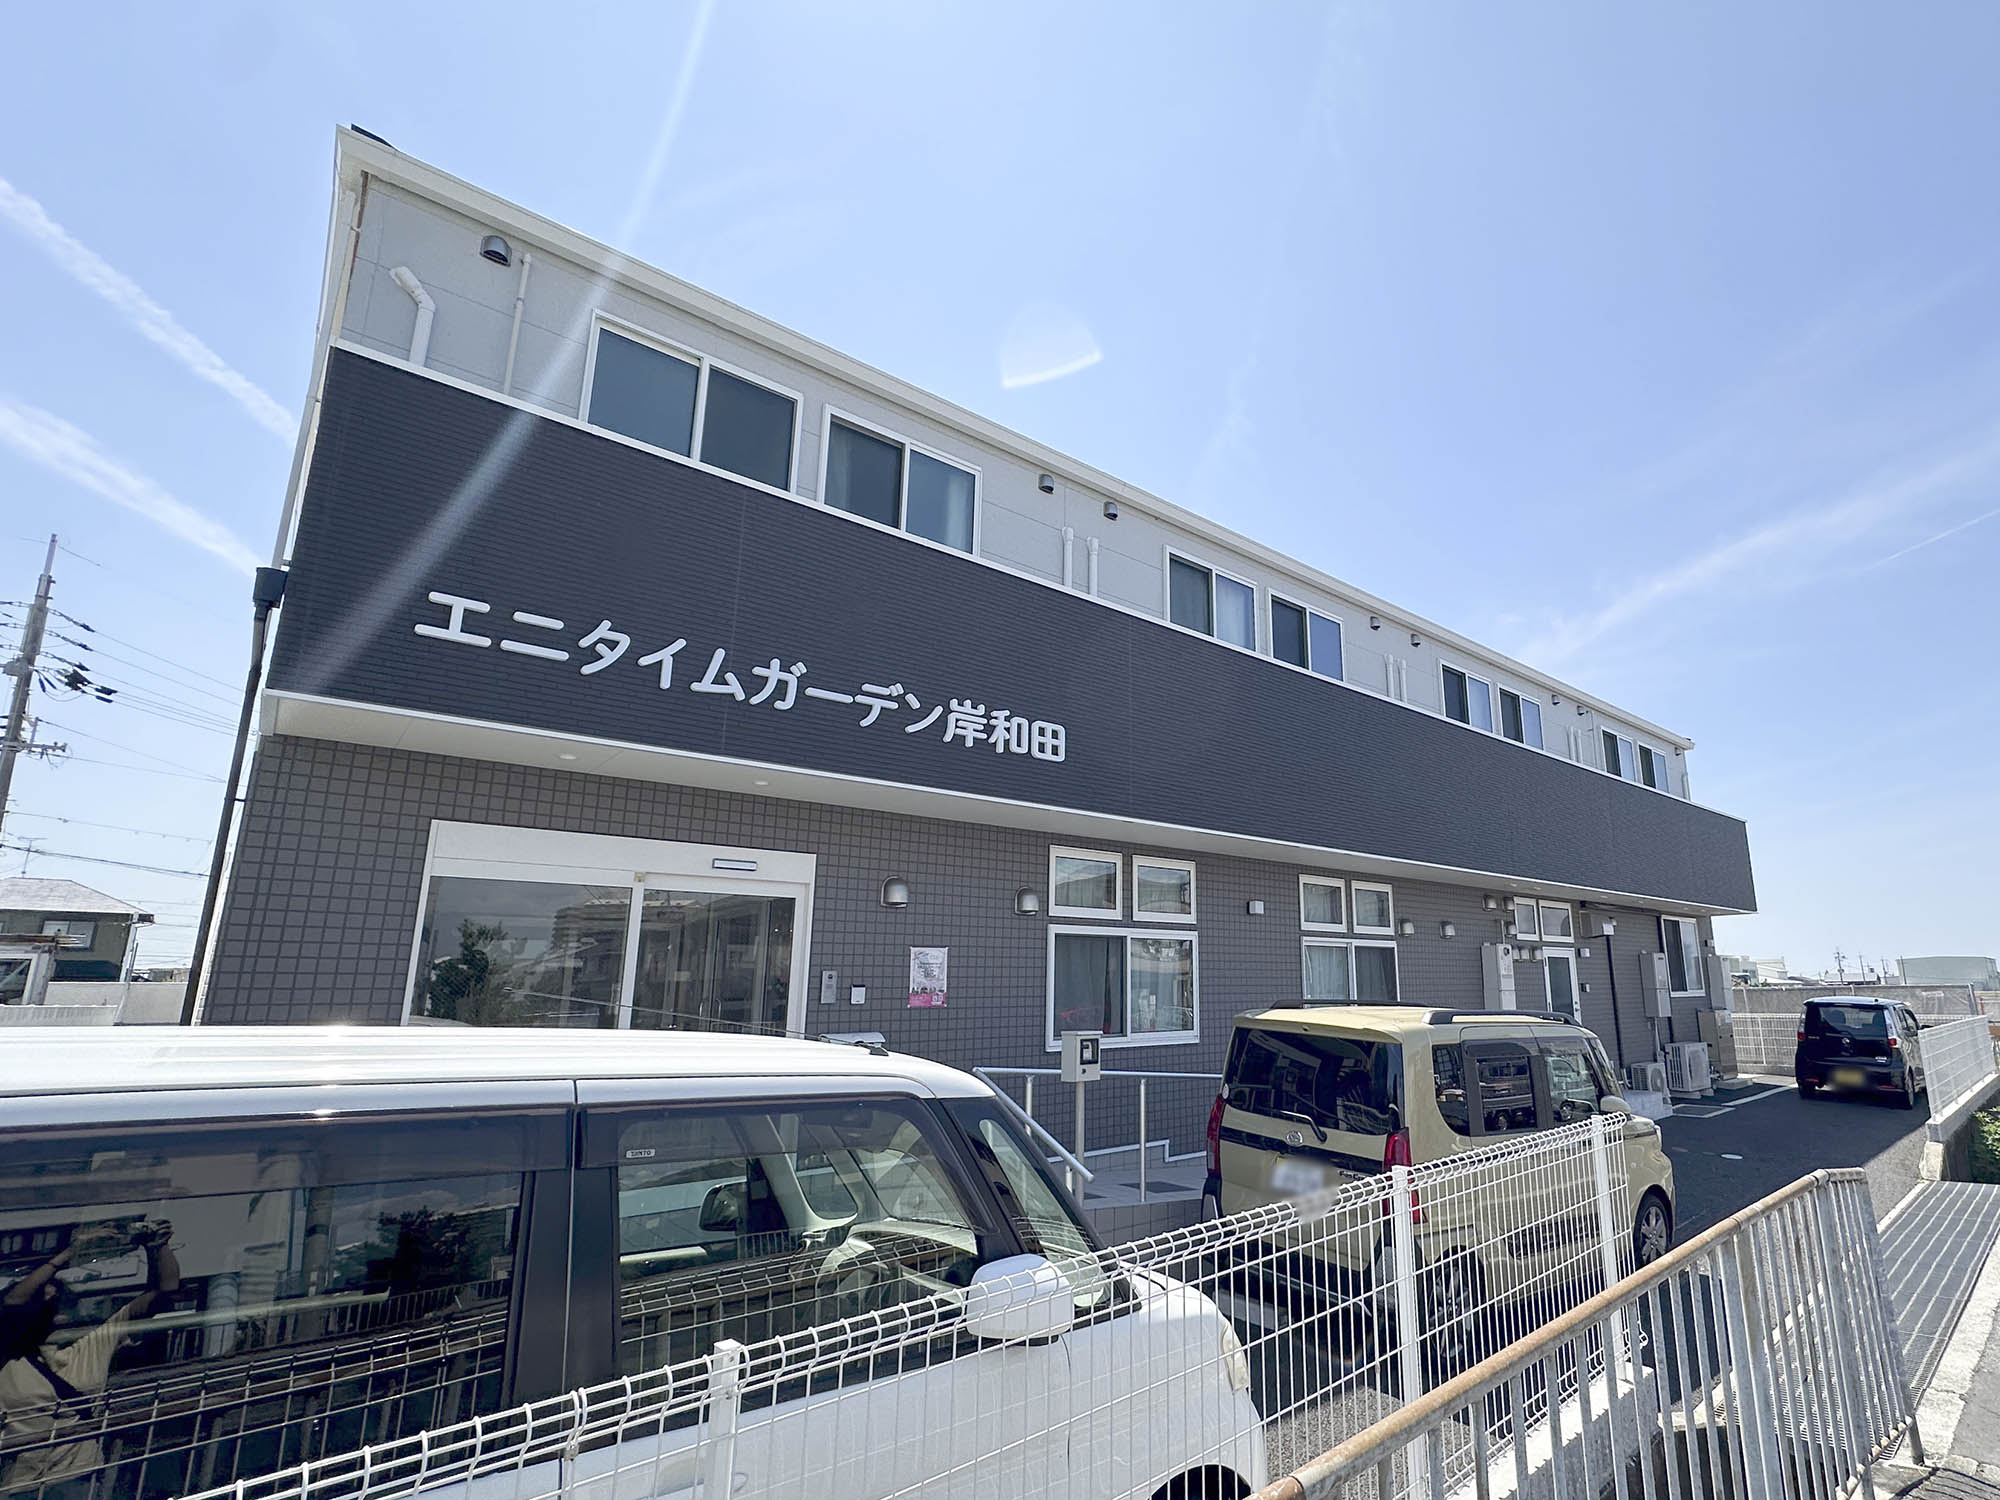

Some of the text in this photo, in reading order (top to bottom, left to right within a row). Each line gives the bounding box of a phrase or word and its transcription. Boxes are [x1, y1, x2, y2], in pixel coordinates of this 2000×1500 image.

[414, 591, 1066, 762] エニタイムガーデン岸和田
